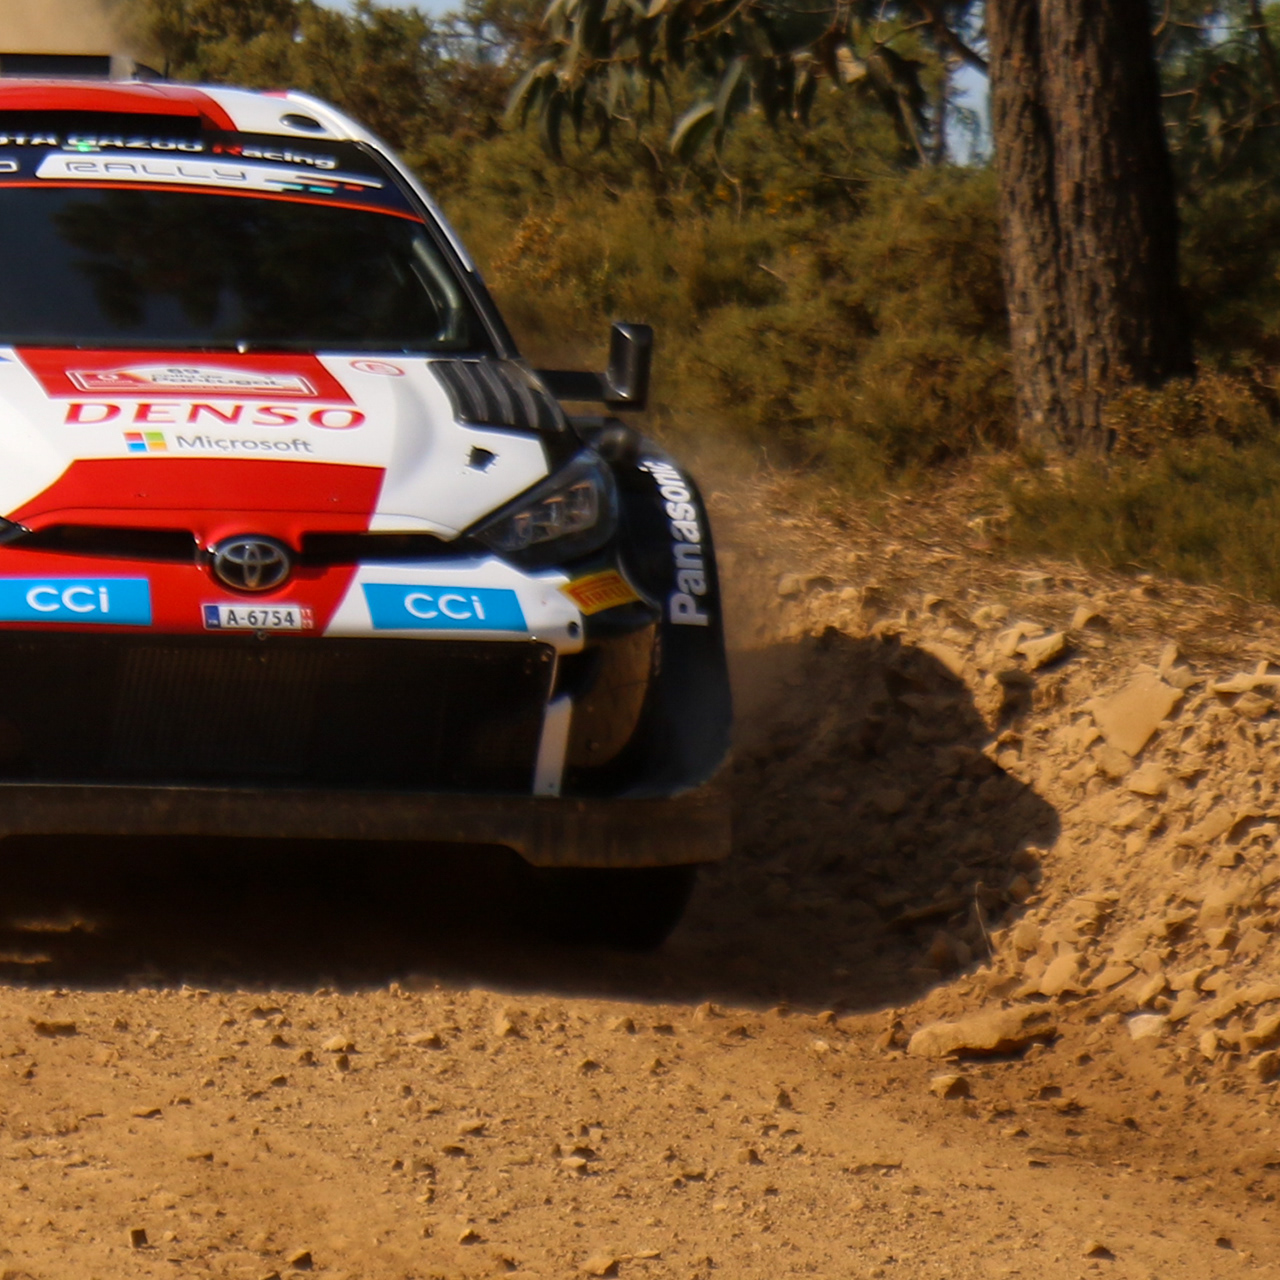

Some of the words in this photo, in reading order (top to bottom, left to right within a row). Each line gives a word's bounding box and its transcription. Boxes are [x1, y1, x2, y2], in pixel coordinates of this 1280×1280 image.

[67, 136, 203, 152] GAZOO
[213, 144, 336, 170] Racing
[64, 161, 248, 182] RALLY
[64, 403, 366, 431] DENSO
[175, 434, 313, 454] Microsoft
[638, 460, 709, 627] Panasonic
[226, 609, 295, 627] A-6754
